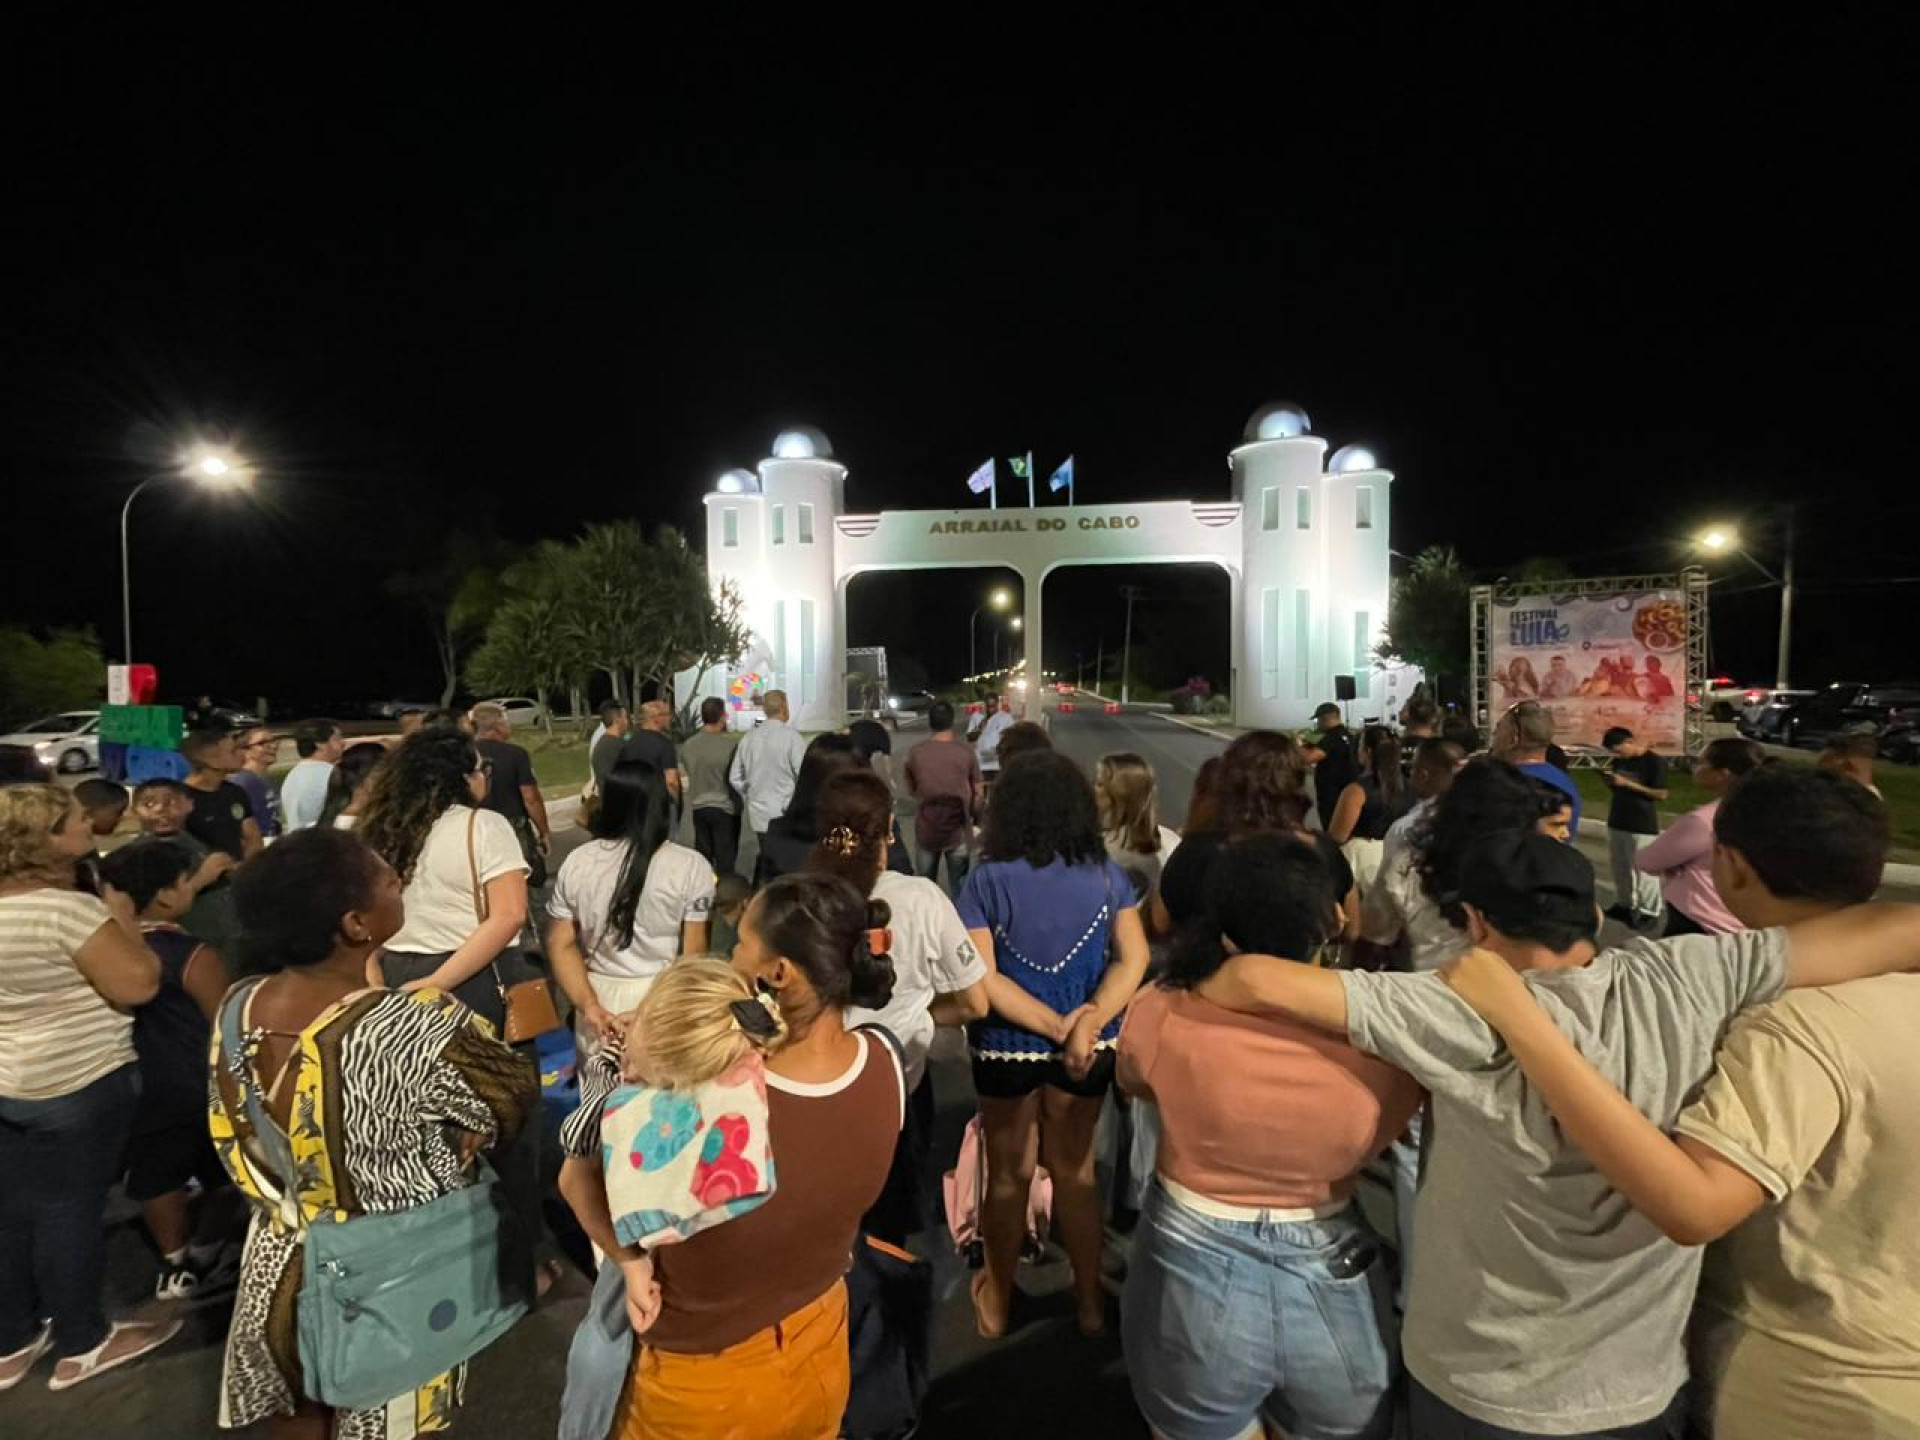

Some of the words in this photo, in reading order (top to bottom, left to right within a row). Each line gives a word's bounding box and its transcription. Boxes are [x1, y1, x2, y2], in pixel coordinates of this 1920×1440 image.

[929, 519, 1027, 534] ARRAIAL
[1036, 518, 1067, 531] DO
[1078, 515, 1140, 530] CABO
[1510, 609, 1558, 624] FESTIVAL
